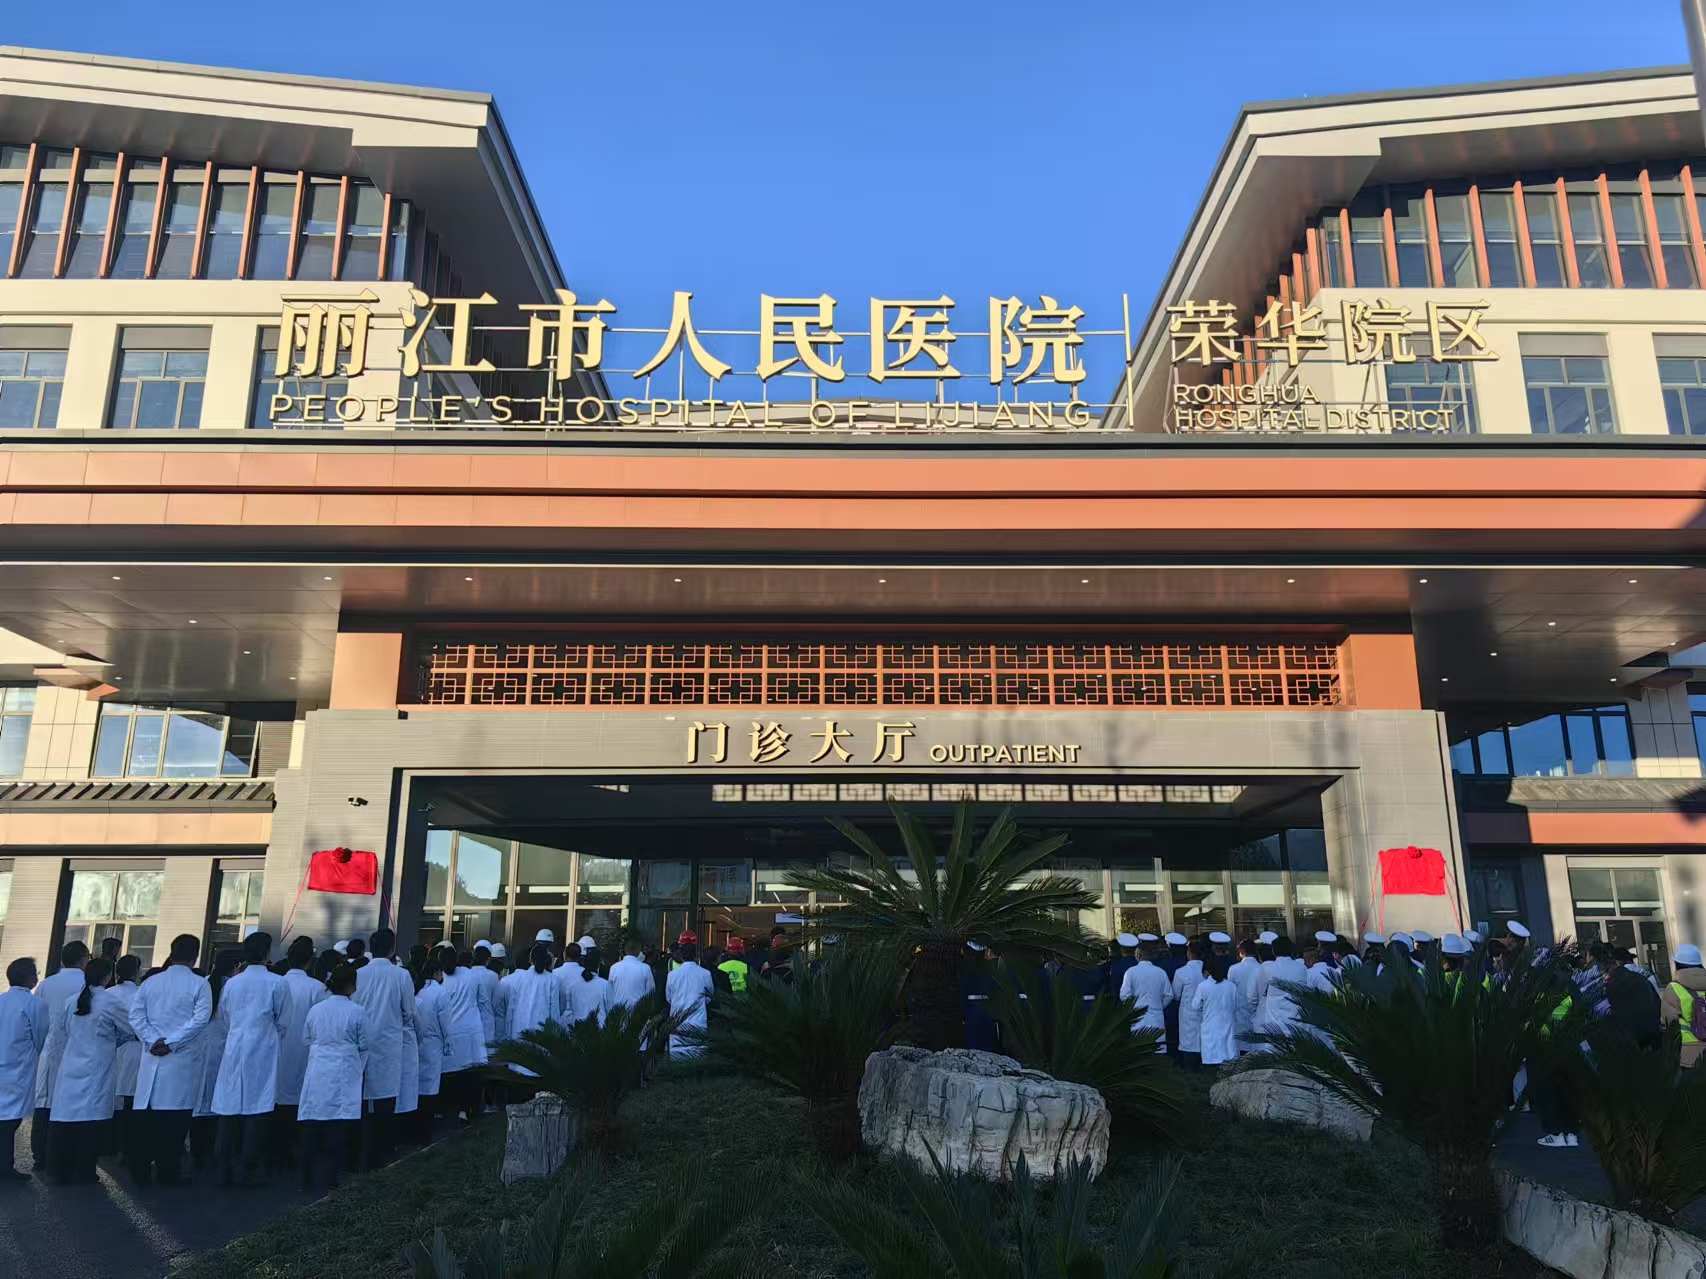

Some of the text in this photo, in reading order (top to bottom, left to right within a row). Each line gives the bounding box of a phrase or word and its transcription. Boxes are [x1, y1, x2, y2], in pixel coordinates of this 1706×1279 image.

[275, 288, 1088, 384] 丽江市人民医院
[1167, 297, 1501, 367] 荣华院区
[269, 394, 1092, 428] PEOPLE'S HOSPITAL OF LIJIANG
[1173, 383, 1320, 405] RONGHUA
[1175, 406, 1454, 432] HOSPITAL DISTRICT
[687, 719, 918, 764] 门诊大厅
[929, 744, 1081, 764] OUTPATIENT
